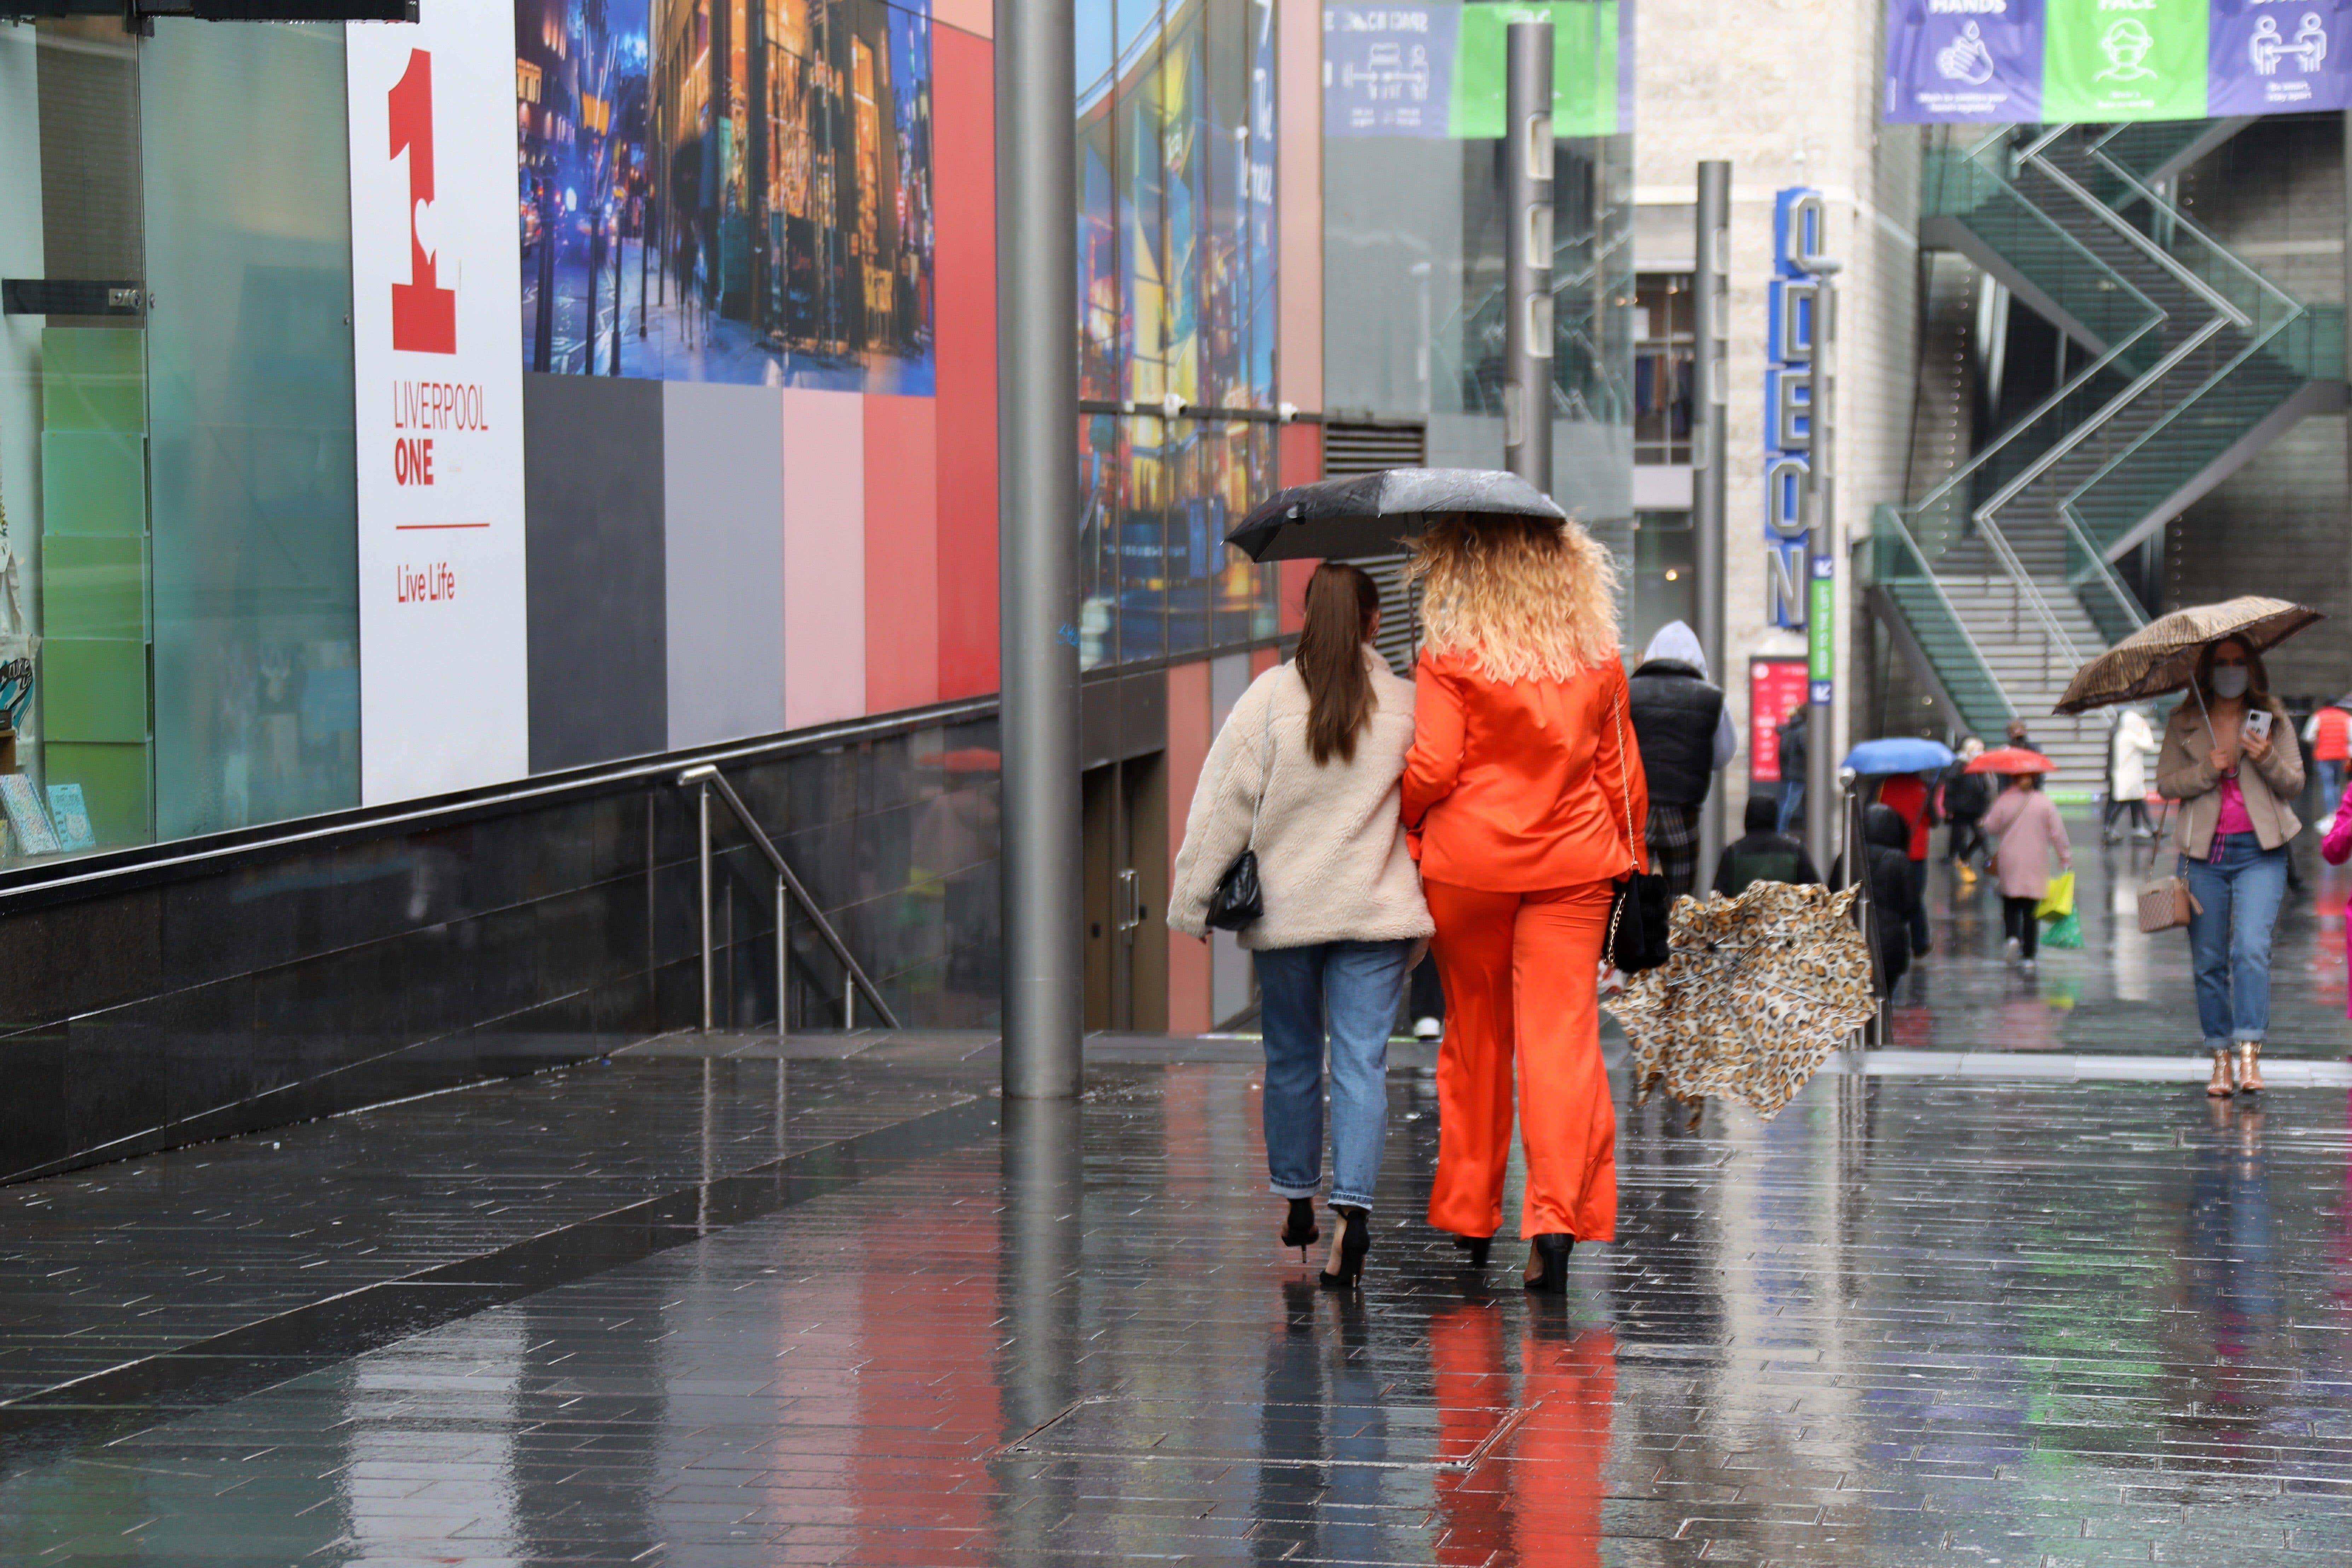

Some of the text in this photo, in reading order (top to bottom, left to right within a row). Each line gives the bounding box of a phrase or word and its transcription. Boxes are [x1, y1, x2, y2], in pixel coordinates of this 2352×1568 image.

[394, 380, 488, 430] LIVERPOOL
[1768, 194, 1826, 625] ODEON
[395, 438, 434, 486] ONE
[398, 561, 455, 603] Live Life
